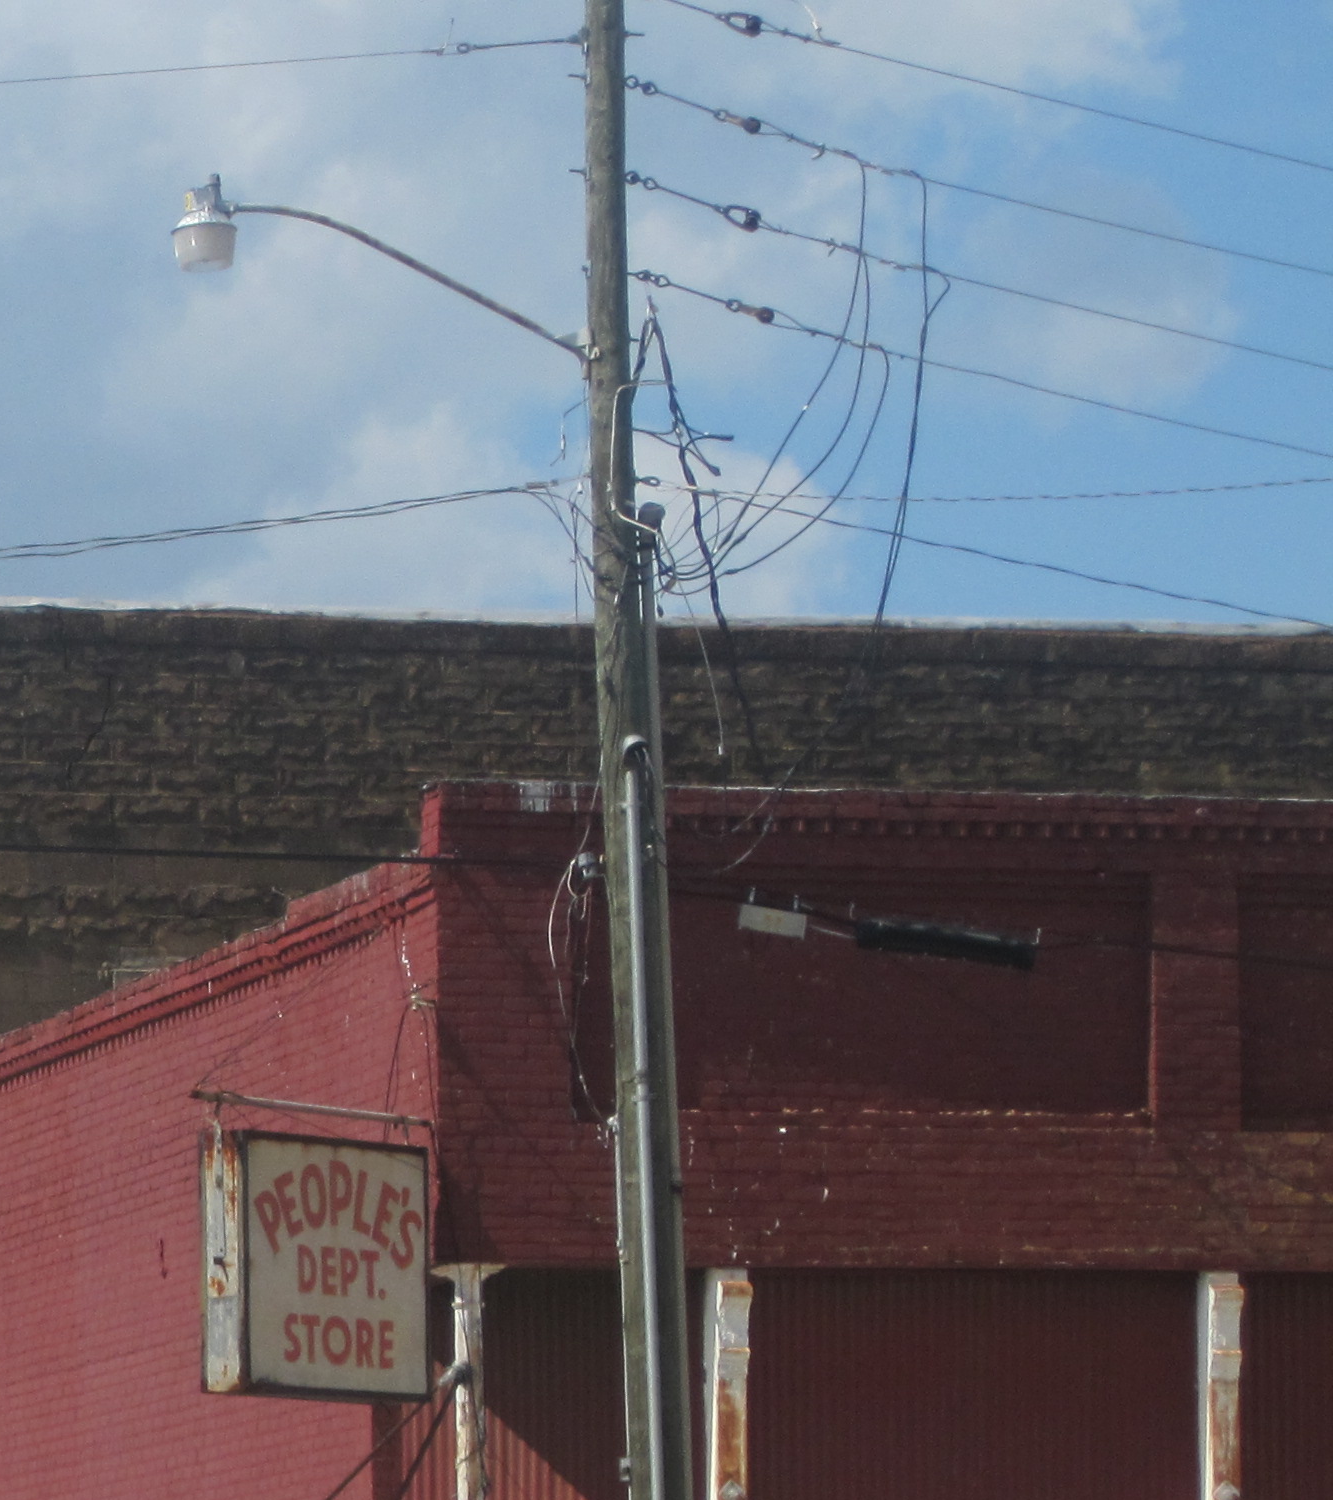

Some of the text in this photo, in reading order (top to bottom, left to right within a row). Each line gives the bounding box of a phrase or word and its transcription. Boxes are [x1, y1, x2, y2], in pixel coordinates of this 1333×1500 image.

[254, 1160, 422, 1270] PEOPLE'S
[297, 1244, 386, 1300] DEPT.
[284, 1313, 394, 1369] STORE
